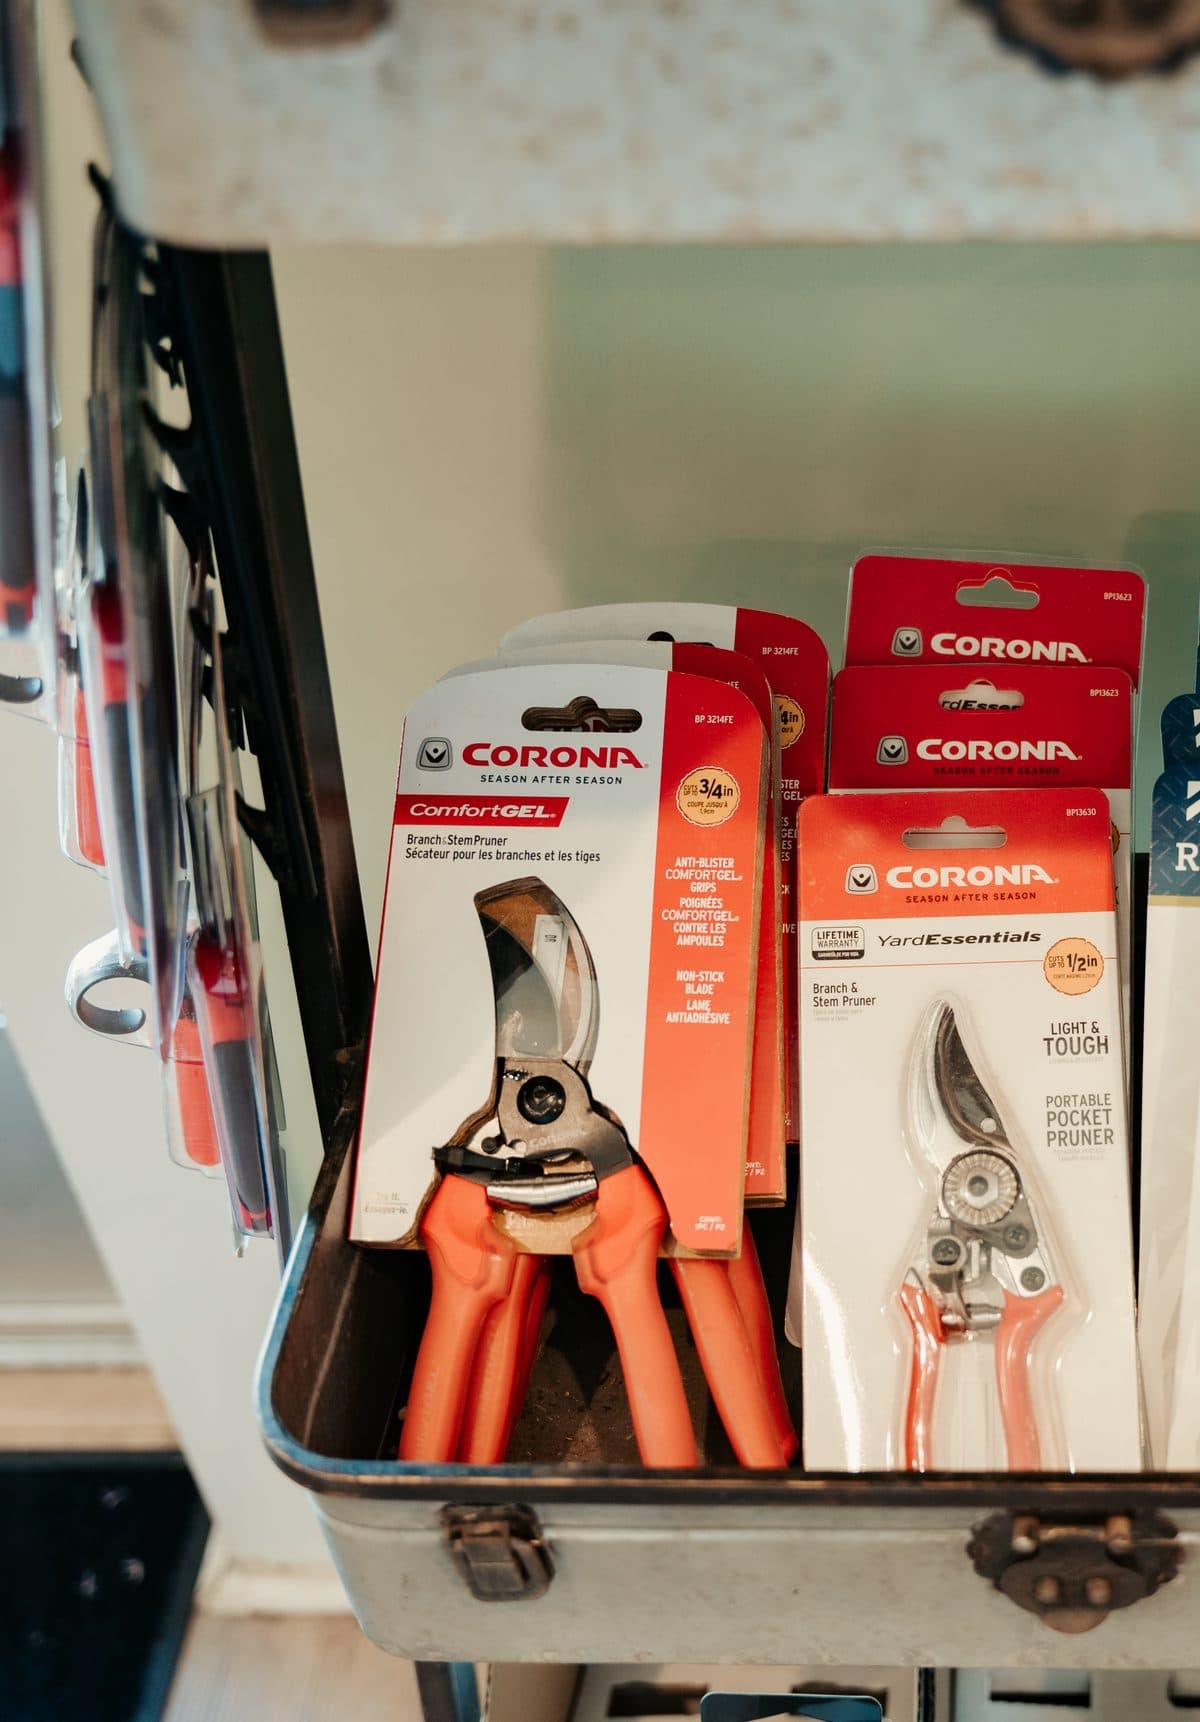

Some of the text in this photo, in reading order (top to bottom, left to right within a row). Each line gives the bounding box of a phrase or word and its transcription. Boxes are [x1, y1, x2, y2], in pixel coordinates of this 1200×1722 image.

[1104, 592, 1132, 601] BP13623
[762, 647, 799, 656] BP 3214FE
[930, 632, 1088, 663] CORONA
[1090, 689, 1119, 697] BP13623
[695, 715, 734, 724] BP 3214FE
[462, 743, 645, 768] CORONA
[916, 739, 1079, 761] CORONA
[933, 767, 1059, 775] SEASON AFTER SEASON
[480, 774, 623, 785] SEASON AFTER SEASON
[1066, 808, 1096, 816] BP13630
[407, 834, 508, 846] Branch Stem Pruner
[405, 847, 601, 863] Sécateur pour les branches et les tiges
[675, 857, 734, 868] ANTI-BLISTER
[886, 865, 1053, 888] CORONA
[690, 882, 716, 893] GRIPS
[680, 895, 723, 908] POIGNÉES
[906, 892, 1037, 903] SEASON AFTER SEASON
[673, 922, 726, 934] CONTRE LES
[677, 935, 724, 947] AMPOULES
[817, 931, 859, 940] LIFETIME
[878, 931, 1041, 947] YardEssentials
[817, 940, 859, 948] WARRANTY
[676, 971, 724, 982] NON-STICK
[685, 984, 714, 995] BLADE
[813, 982, 858, 994] Branch &
[686, 1000, 711, 1011] LAME
[813, 996, 876, 1007] Stem Pruner
[666, 1009, 730, 1024] ANTIADHÉSIVE
[1051, 1021, 1100, 1035] LIGHT &
[1042, 1035, 1109, 1056] TOUGH
[1046, 1093, 1112, 1108] PORTABLE
[1047, 1108, 1112, 1127] POCKET
[1047, 1128, 1114, 1147] PRUNER
